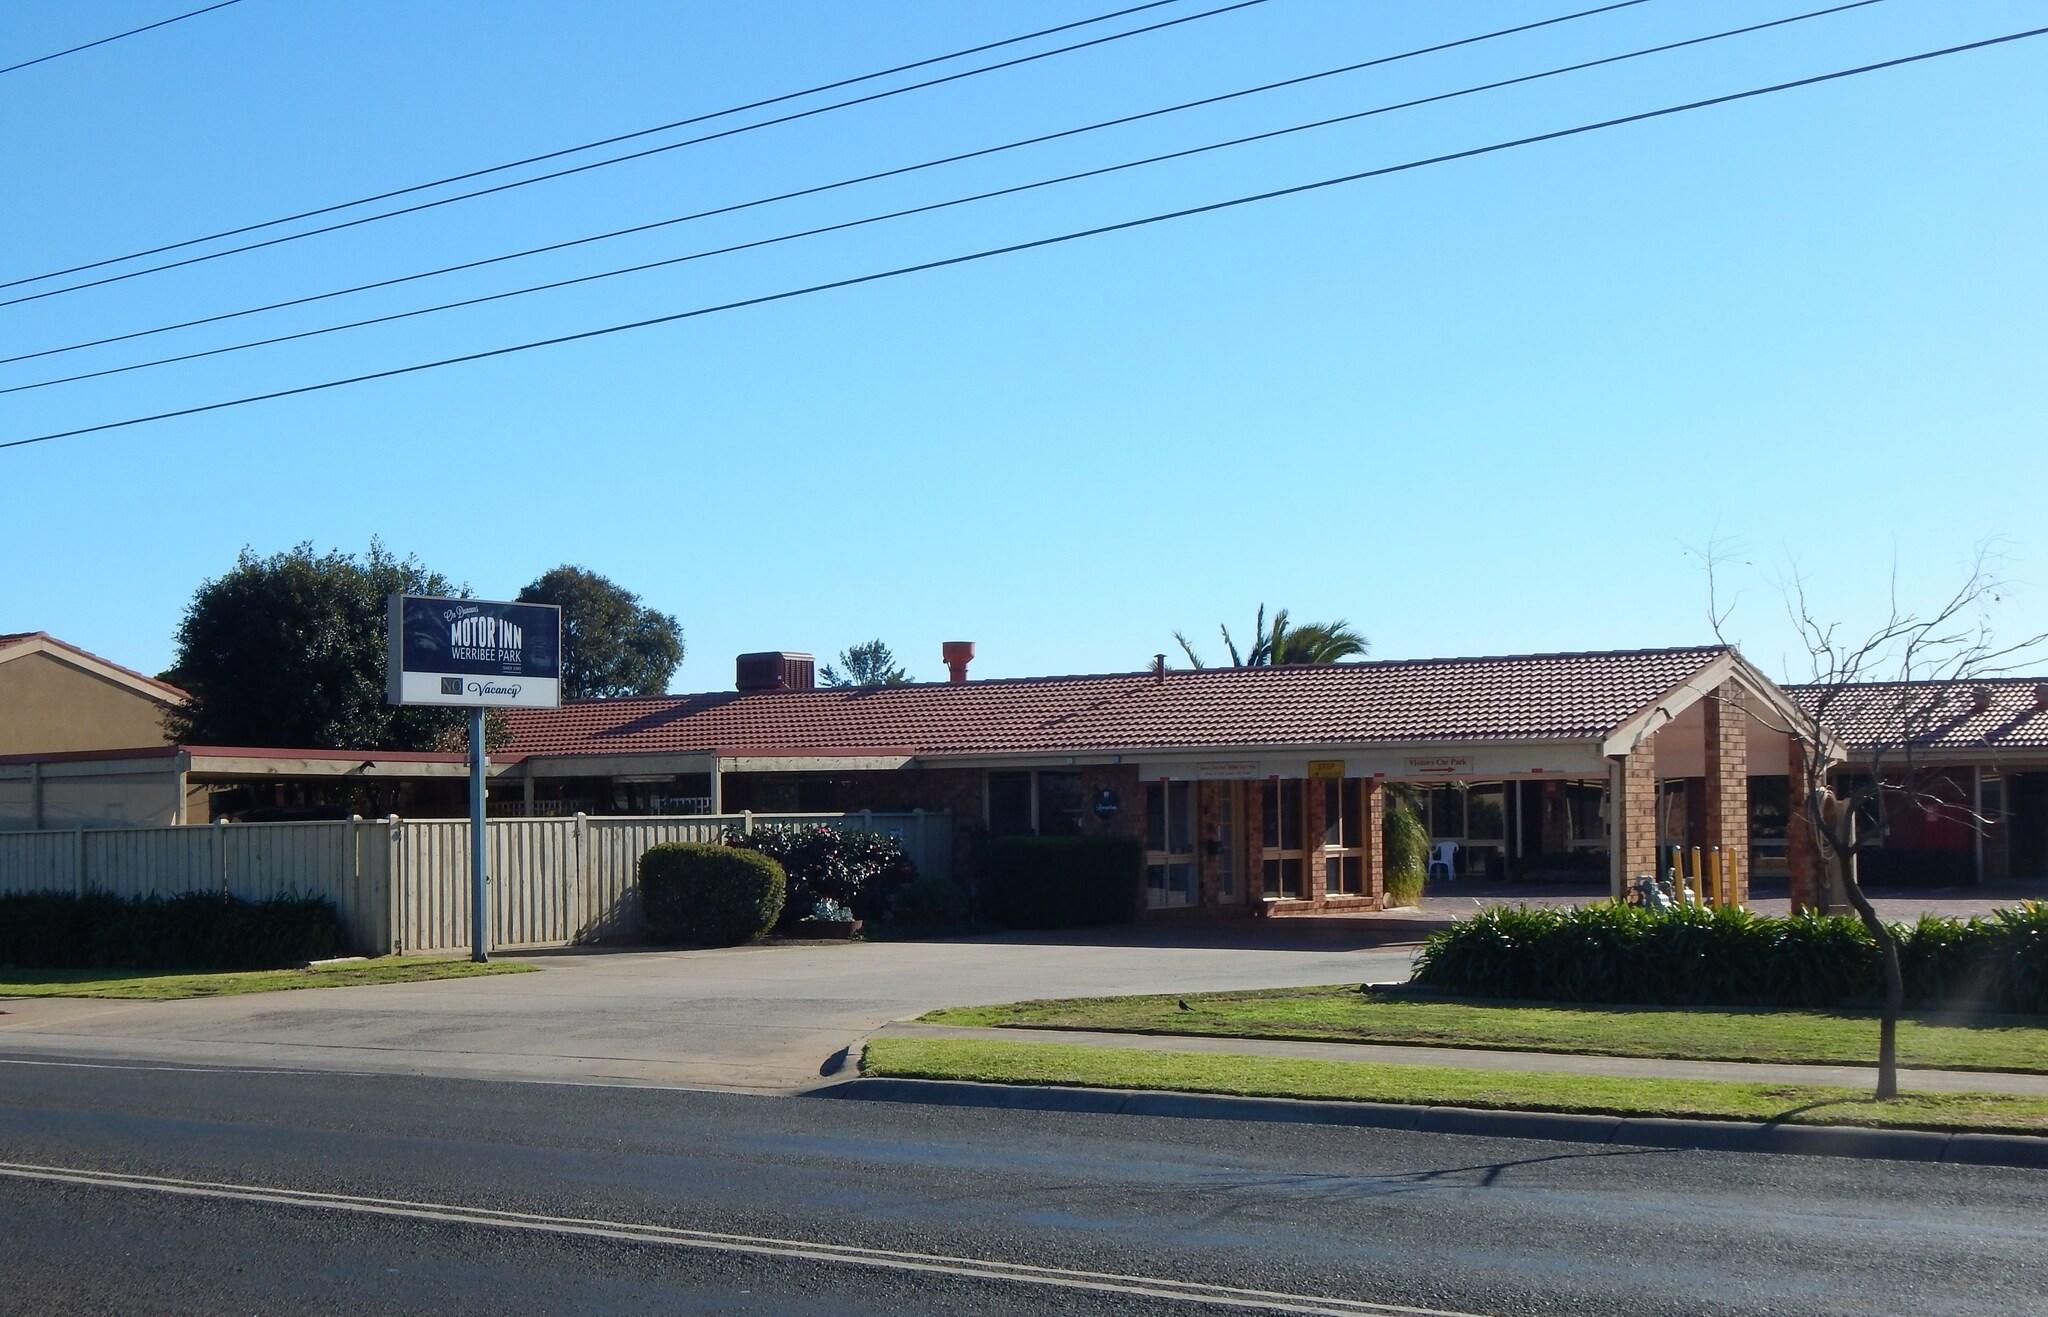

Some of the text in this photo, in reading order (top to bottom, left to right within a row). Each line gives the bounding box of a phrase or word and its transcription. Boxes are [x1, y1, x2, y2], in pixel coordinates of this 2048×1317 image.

[451, 616, 522, 650] MOTOR INN
[451, 647, 522, 663] WERRIBEE PARK
[442, 679, 522, 698] NO Vacancy
[1450, 758, 1467, 766] Park
